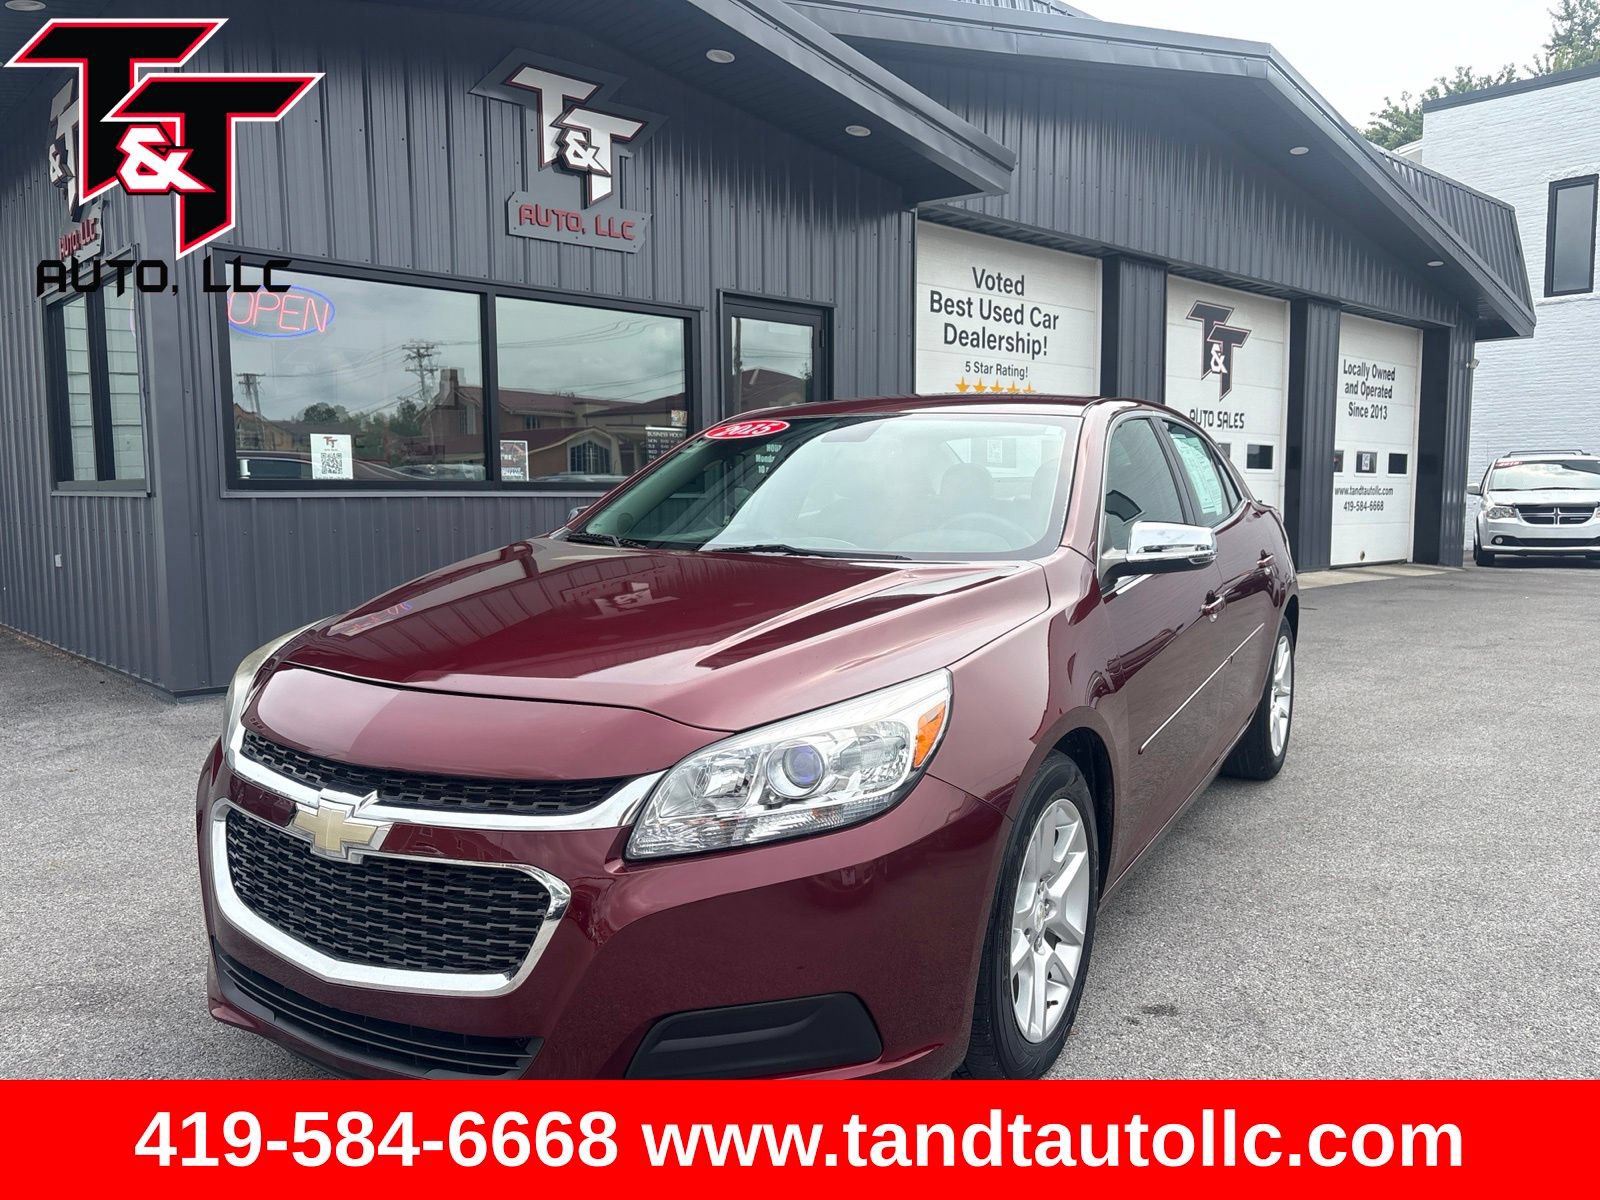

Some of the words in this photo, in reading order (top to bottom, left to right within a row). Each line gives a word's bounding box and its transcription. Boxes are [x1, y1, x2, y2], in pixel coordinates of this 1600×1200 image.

[505, 64, 648, 206] T&T
[519, 204, 586, 234] AUTO,
[595, 215, 635, 240] LLC
[972, 266, 1025, 296] Voted
[228, 290, 330, 333] OPEN
[930, 290, 973, 318] Best
[979, 298, 1024, 325] Used
[1029, 306, 1059, 330] Car
[944, 322, 1048, 360] Dealership!
[1186, 300, 1252, 401] T&T
[965, 360, 971, 373] 5
[973, 361, 993, 375] Star
[995, 363, 1029, 380] Rating!
[1343, 358, 1370, 381] Locally
[1371, 363, 1396, 381] Owned
[1344, 380, 1359, 395] and
[1360, 381, 1393, 400] Operated
[1189, 408, 1215, 429] AUTO
[1217, 411, 1245, 429] SALES
[1348, 401, 1369, 418] Since
[1370, 403, 1388, 420] 2013
[711, 422, 781, 437] 2015
[1343, 501, 1384, 512] 419-584-6668
